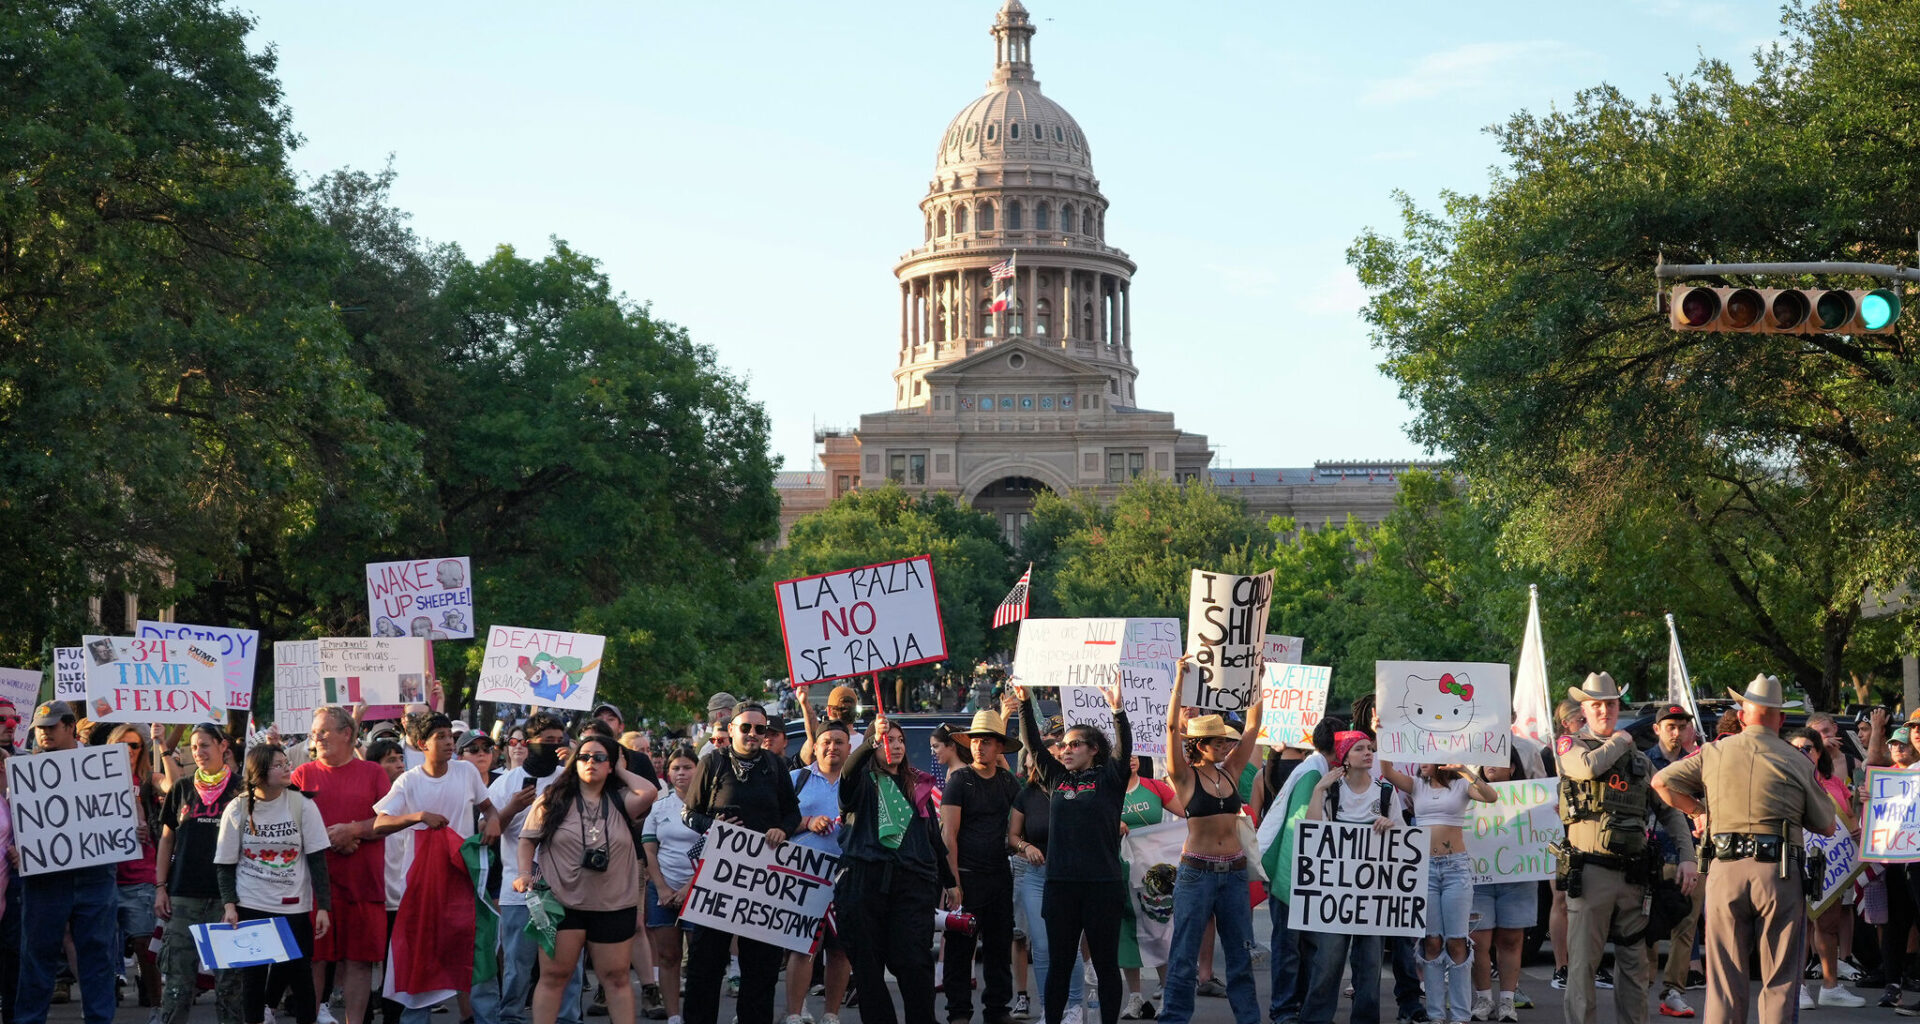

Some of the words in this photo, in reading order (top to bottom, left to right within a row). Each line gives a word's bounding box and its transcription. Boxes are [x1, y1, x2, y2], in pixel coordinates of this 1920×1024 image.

[369, 561, 433, 599] WAKE
[792, 576, 839, 610] LA
[848, 559, 924, 600] RAZA
[1202, 574, 1217, 603] I
[384, 594, 413, 618] UP
[416, 588, 472, 611] SHEEPLE!
[821, 601, 877, 641] NO
[1087, 621, 1120, 641] NOT
[1150, 622, 1177, 642] IS
[1197, 604, 1267, 646] SHIT
[131, 640, 170, 663] 34
[277, 644, 298, 663] NOT
[493, 629, 574, 655] DEATH
[59, 662, 80, 671] NO
[189, 646, 217, 663] DUMP
[488, 655, 508, 669] TO
[800, 646, 837, 682] SE
[844, 633, 924, 674] RAJA
[114, 662, 190, 685] TIME
[320, 662, 338, 672] The
[388, 663, 396, 672] is
[1068, 662, 1120, 685] HUMANS
[1269, 665, 1296, 688] WE
[1299, 665, 1327, 688] THE
[481, 674, 528, 694] TYRANTS
[1123, 669, 1157, 690] Here.
[114, 688, 211, 713] FELON
[1301, 712, 1318, 726] NO
[1136, 732, 1153, 743] FREE
[1269, 726, 1301, 744] KING
[1450, 731, 1507, 756] MIGRA
[12, 758, 61, 795] NO
[72, 751, 123, 783] ICE
[1874, 778, 1894, 799] I
[17, 794, 69, 833] NO
[76, 789, 132, 822] NAZIS
[1873, 802, 1916, 822] WARM
[21, 832, 73, 873] NO
[79, 827, 136, 860] KINGS
[716, 825, 766, 859] YOU
[1299, 822, 1424, 866] FAMILIES
[1871, 828, 1916, 852] FUCK
[712, 858, 820, 906] DEPORT
[1297, 856, 1417, 893] BELONG
[689, 885, 728, 919] THE
[1294, 889, 1426, 929] TOGETHER
